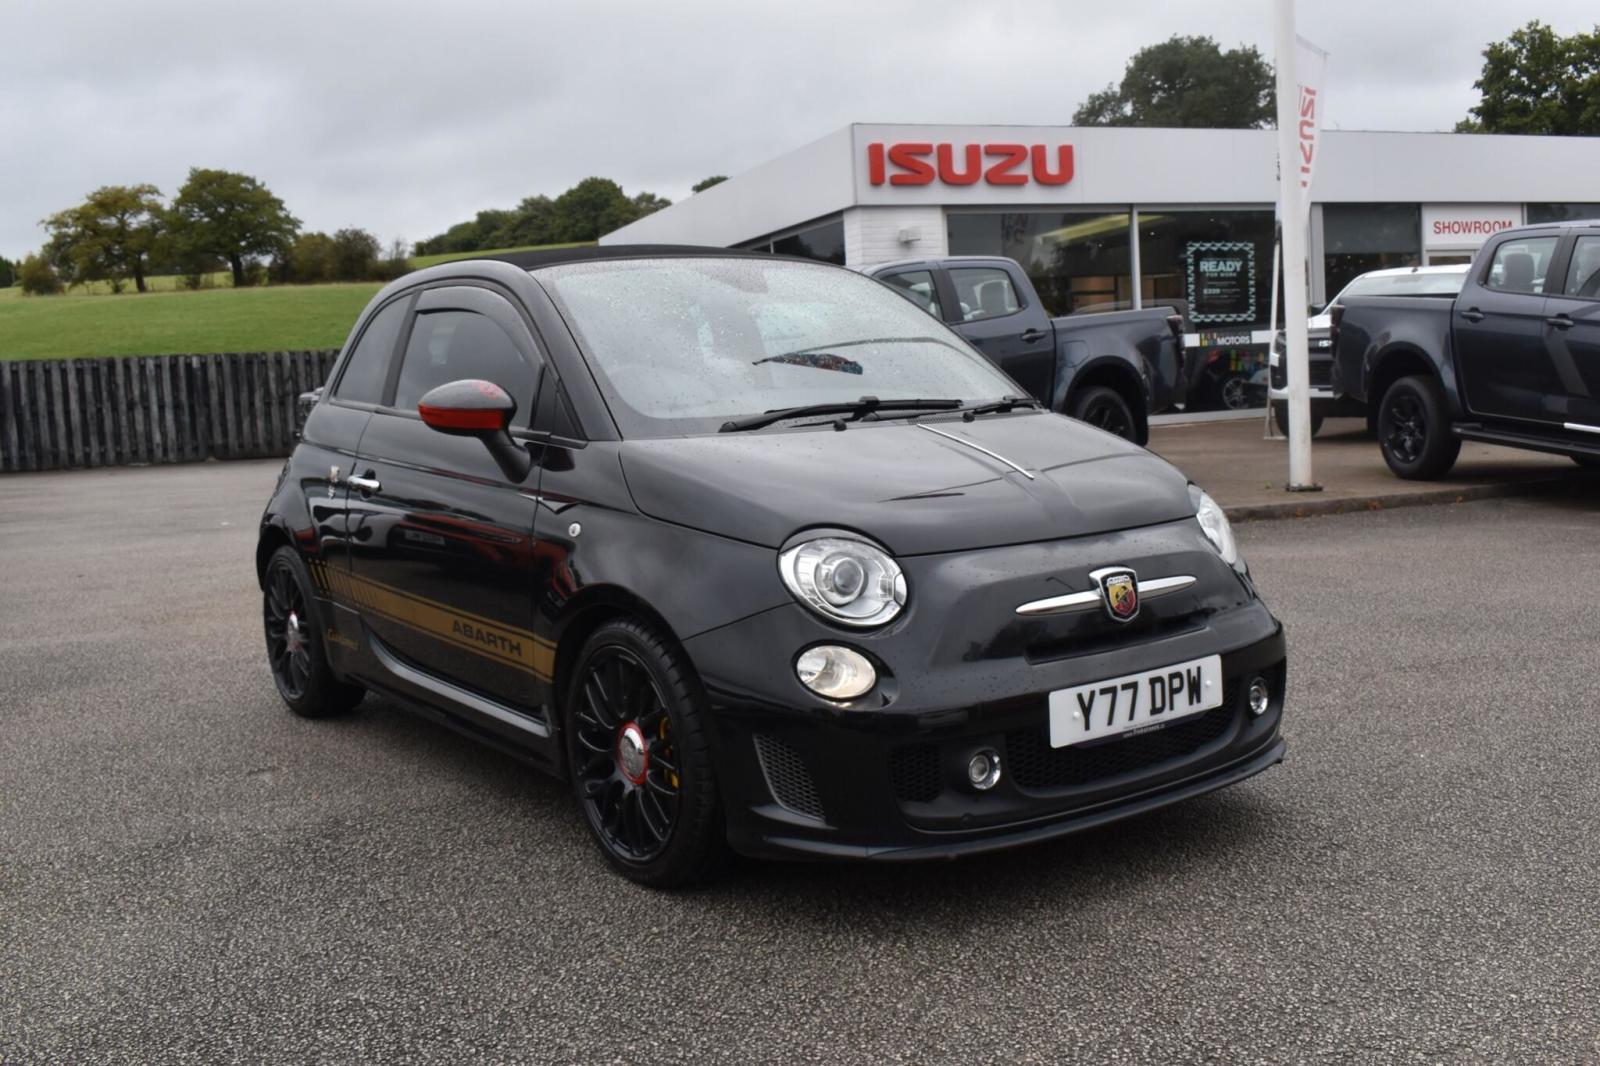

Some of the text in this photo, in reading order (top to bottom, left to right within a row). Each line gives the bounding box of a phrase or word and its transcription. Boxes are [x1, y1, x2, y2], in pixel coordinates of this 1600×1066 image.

[868, 143, 1074, 186] ISUZU
[1199, 260, 1243, 272] READY
[1216, 335, 1250, 346] MOTORS
[452, 619, 522, 657] ABARTH
[1076, 666, 1202, 731] Y77 DPW
